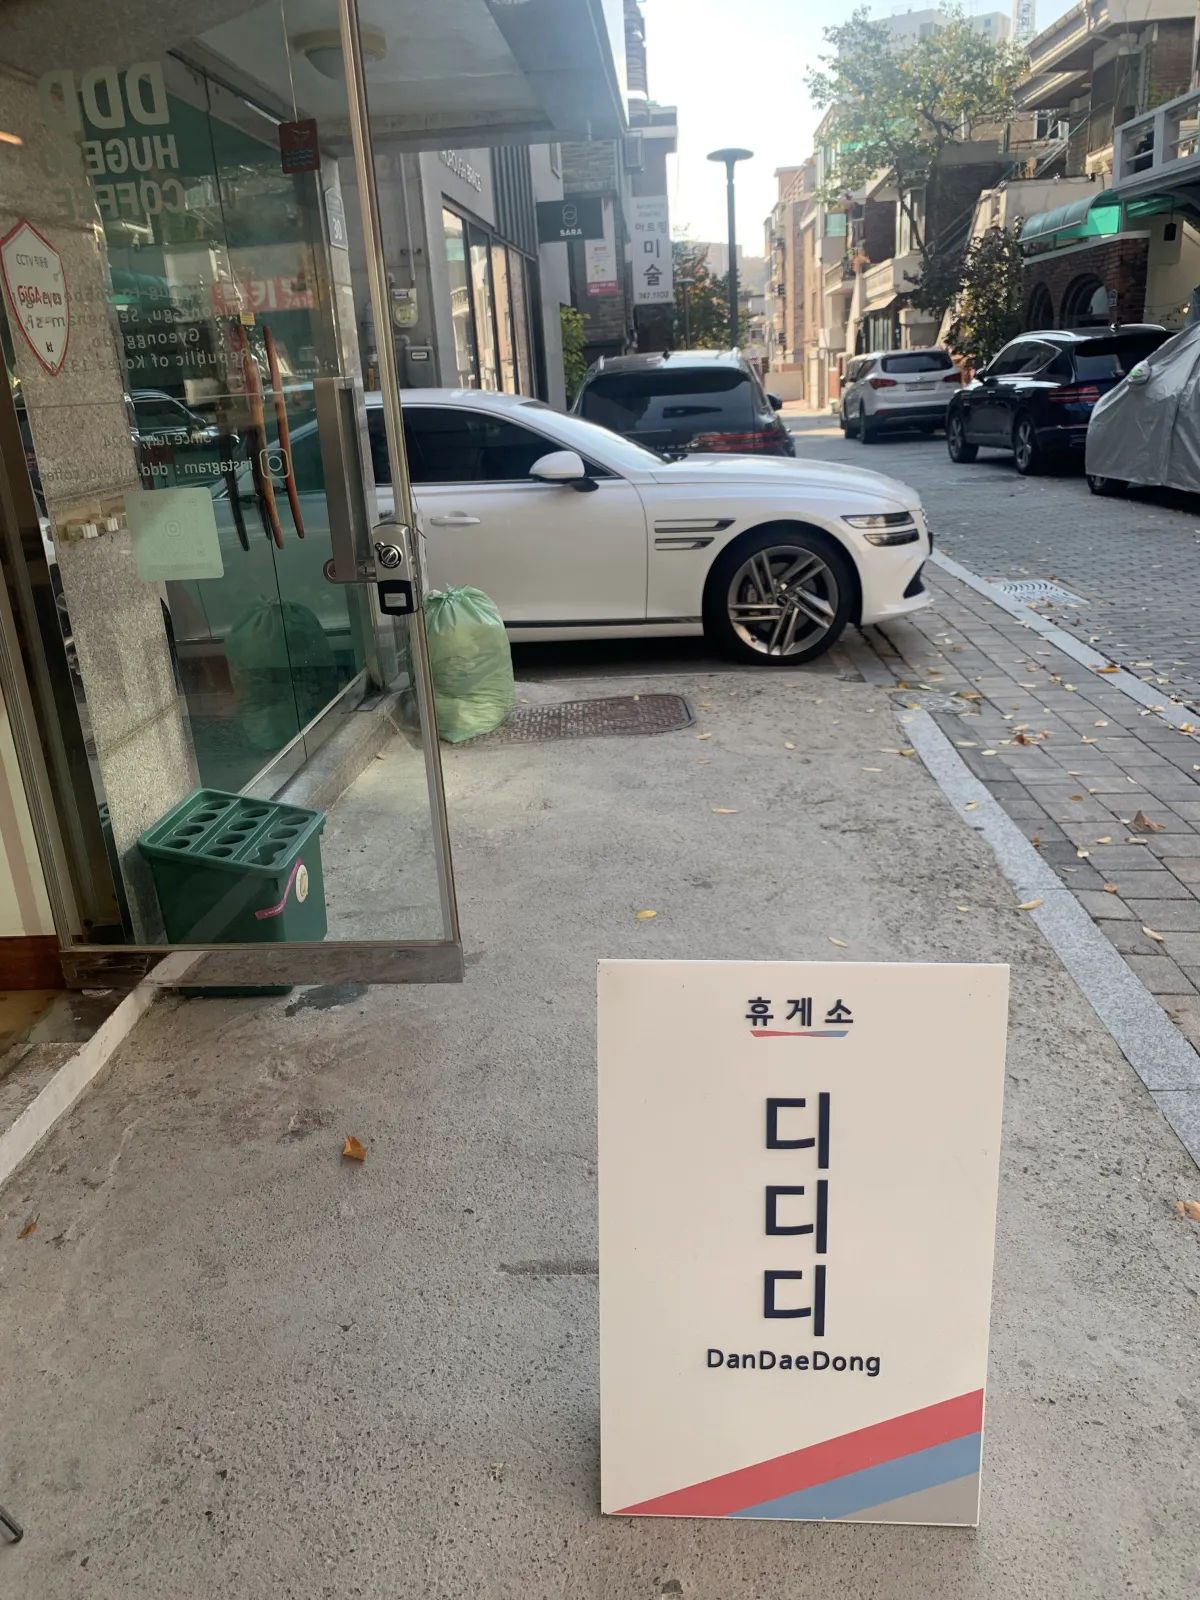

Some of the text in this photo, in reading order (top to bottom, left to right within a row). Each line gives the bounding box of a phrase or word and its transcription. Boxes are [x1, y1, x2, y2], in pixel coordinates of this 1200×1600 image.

[559, 227, 583, 237] SARA
[16, 253, 34, 267] CCTV
[643, 238, 663, 287] 미술
[745, 996, 855, 1027] 휴게소
[764, 1092, 831, 1338] 디디디
[706, 1348, 882, 1378] DanDaeDong
